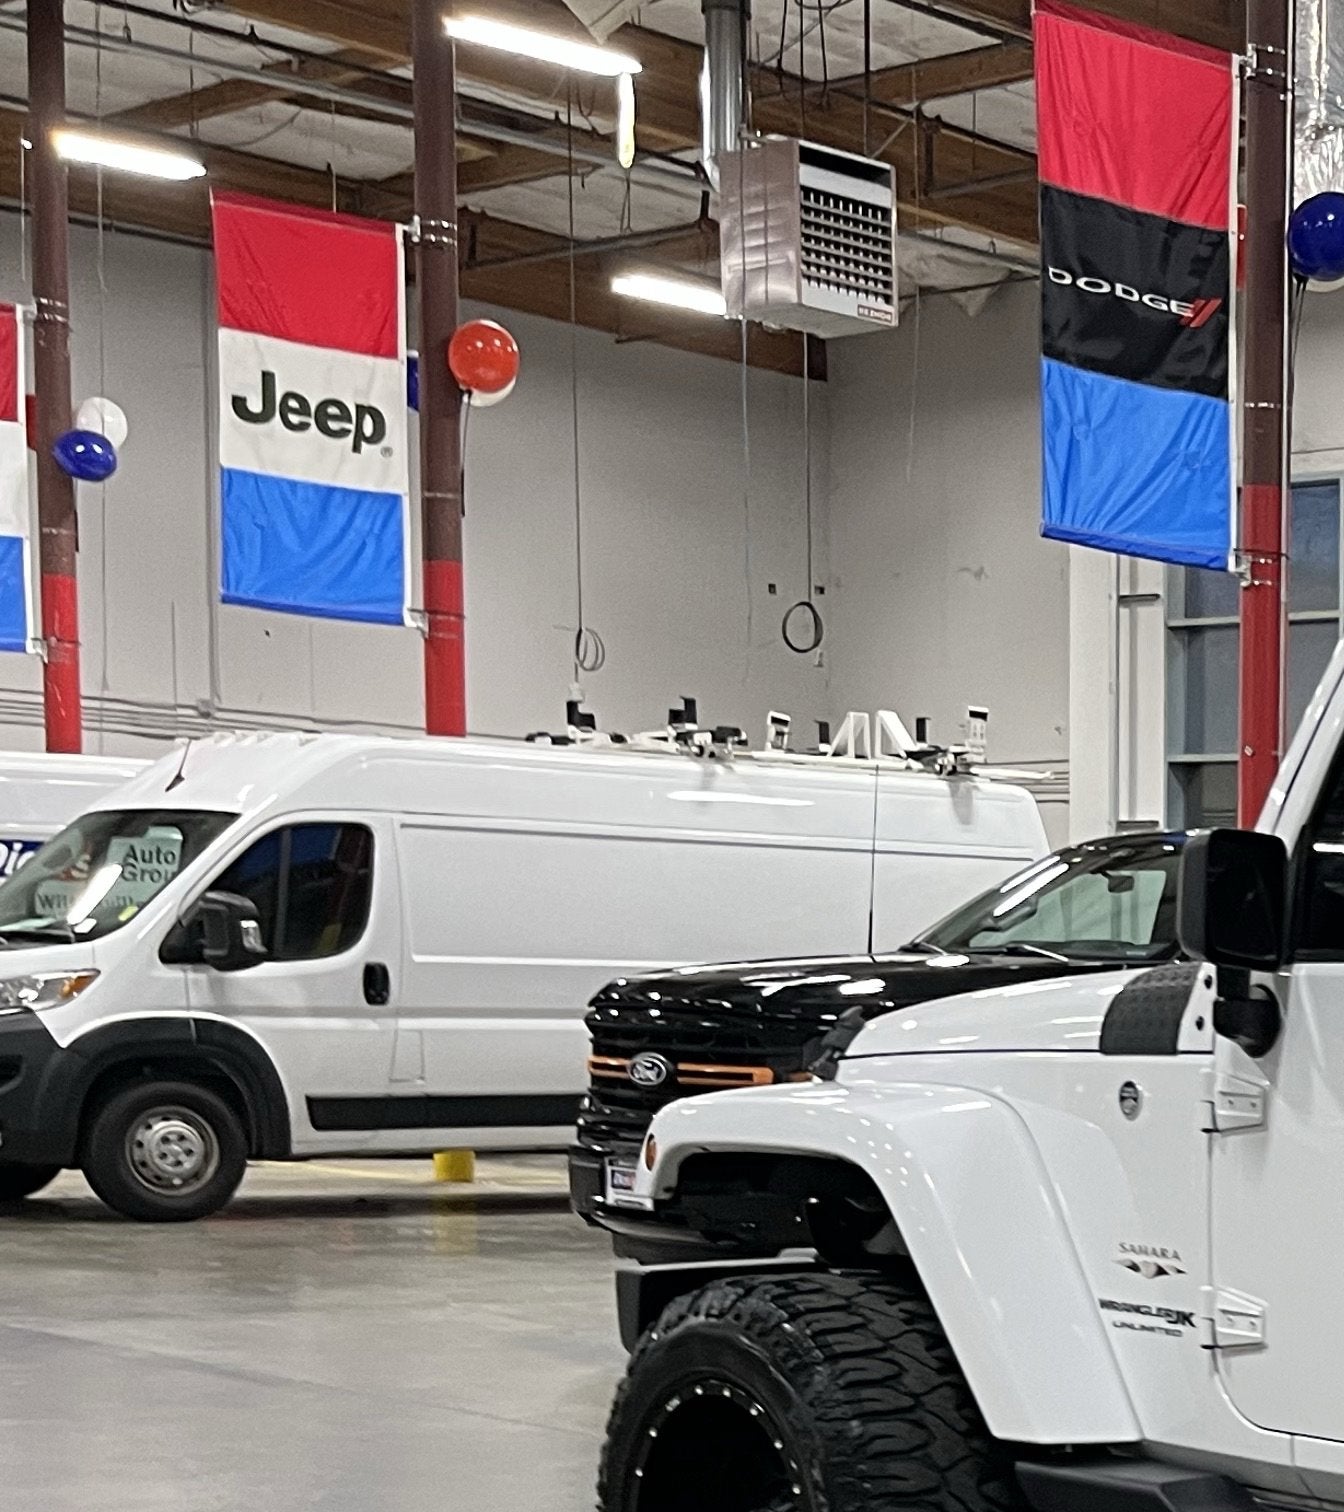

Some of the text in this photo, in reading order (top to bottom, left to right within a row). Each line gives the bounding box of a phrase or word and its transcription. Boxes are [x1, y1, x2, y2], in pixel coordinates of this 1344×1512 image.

[1048, 265, 1195, 318] DODGE
[231, 370, 387, 455] Jeep
[125, 844, 177, 865] Auto
[1118, 1242, 1182, 1262] SAHARA
